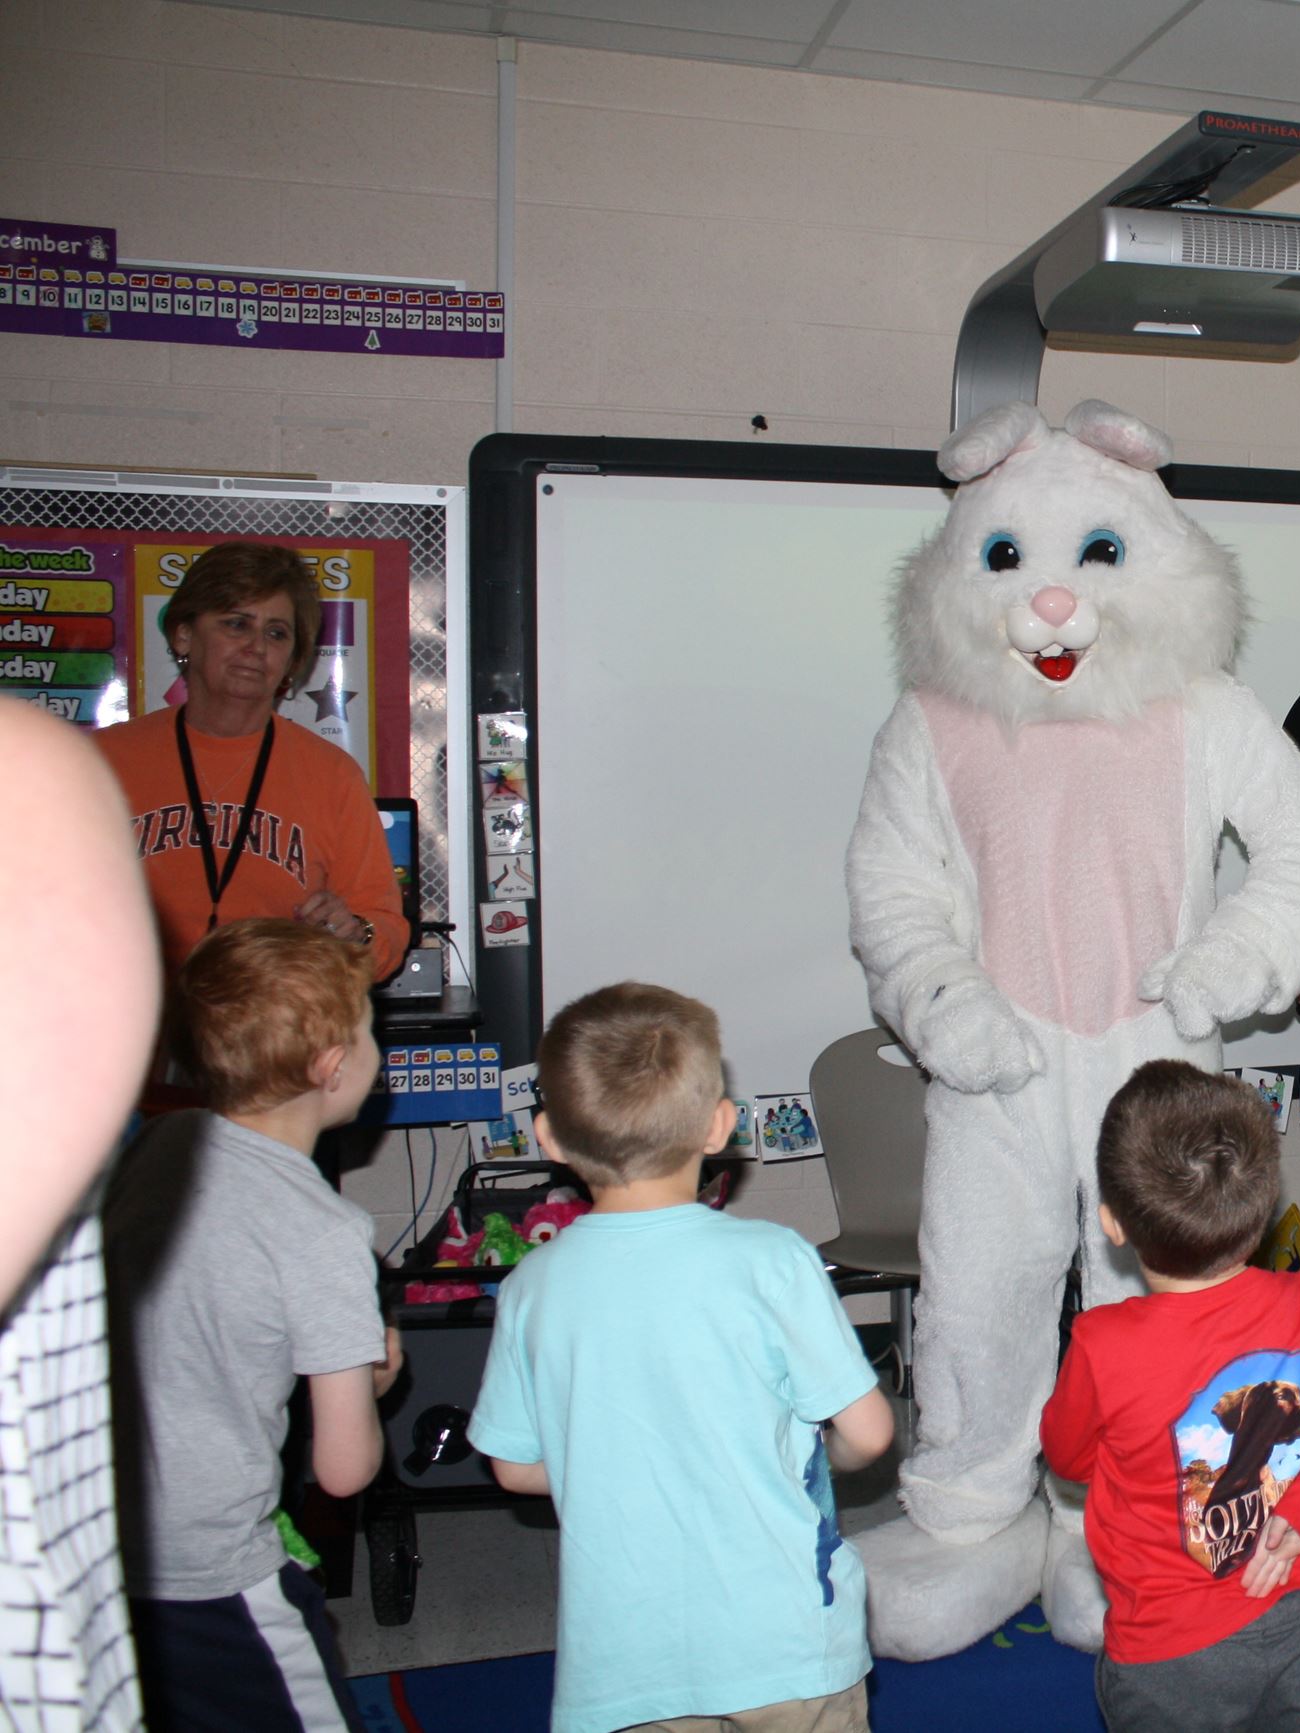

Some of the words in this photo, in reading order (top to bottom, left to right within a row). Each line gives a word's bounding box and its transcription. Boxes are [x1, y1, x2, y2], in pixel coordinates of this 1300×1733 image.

[21, 289, 30, 300] 9
[41, 290, 56, 302] 10
[68, 292, 78, 303] 11
[89, 294, 102, 305] 12
[111, 295, 124, 306] 13
[133, 295, 147, 308] 14
[156, 297, 169, 309] 15
[178, 298, 191, 311] 16
[200, 300, 212, 312] 17
[221, 302, 233, 313] 18
[243, 303, 255, 315] 19
[262, 305, 278, 317] 20
[284, 307, 296, 318] 21
[304, 308, 318, 319] 22
[325, 309, 340, 320] 23
[345, 310, 360, 321] 24
[366, 311, 381, 323] 25
[386, 312, 401, 324] 26
[407, 314, 421, 325] 27
[428, 315, 442, 326] 28
[448, 316, 462, 326] 29
[467, 317, 482, 328] 30
[488, 317, 500, 328] 31
[29, 550, 90, 570] week
[130, 803, 308, 889] IRGINIA
[391, 1074, 407, 1088] 27
[413, 1073, 431, 1087] 28
[436, 1071, 452, 1086] 29
[458, 1071, 476, 1086] 30
[482, 1070, 496, 1084] 31
